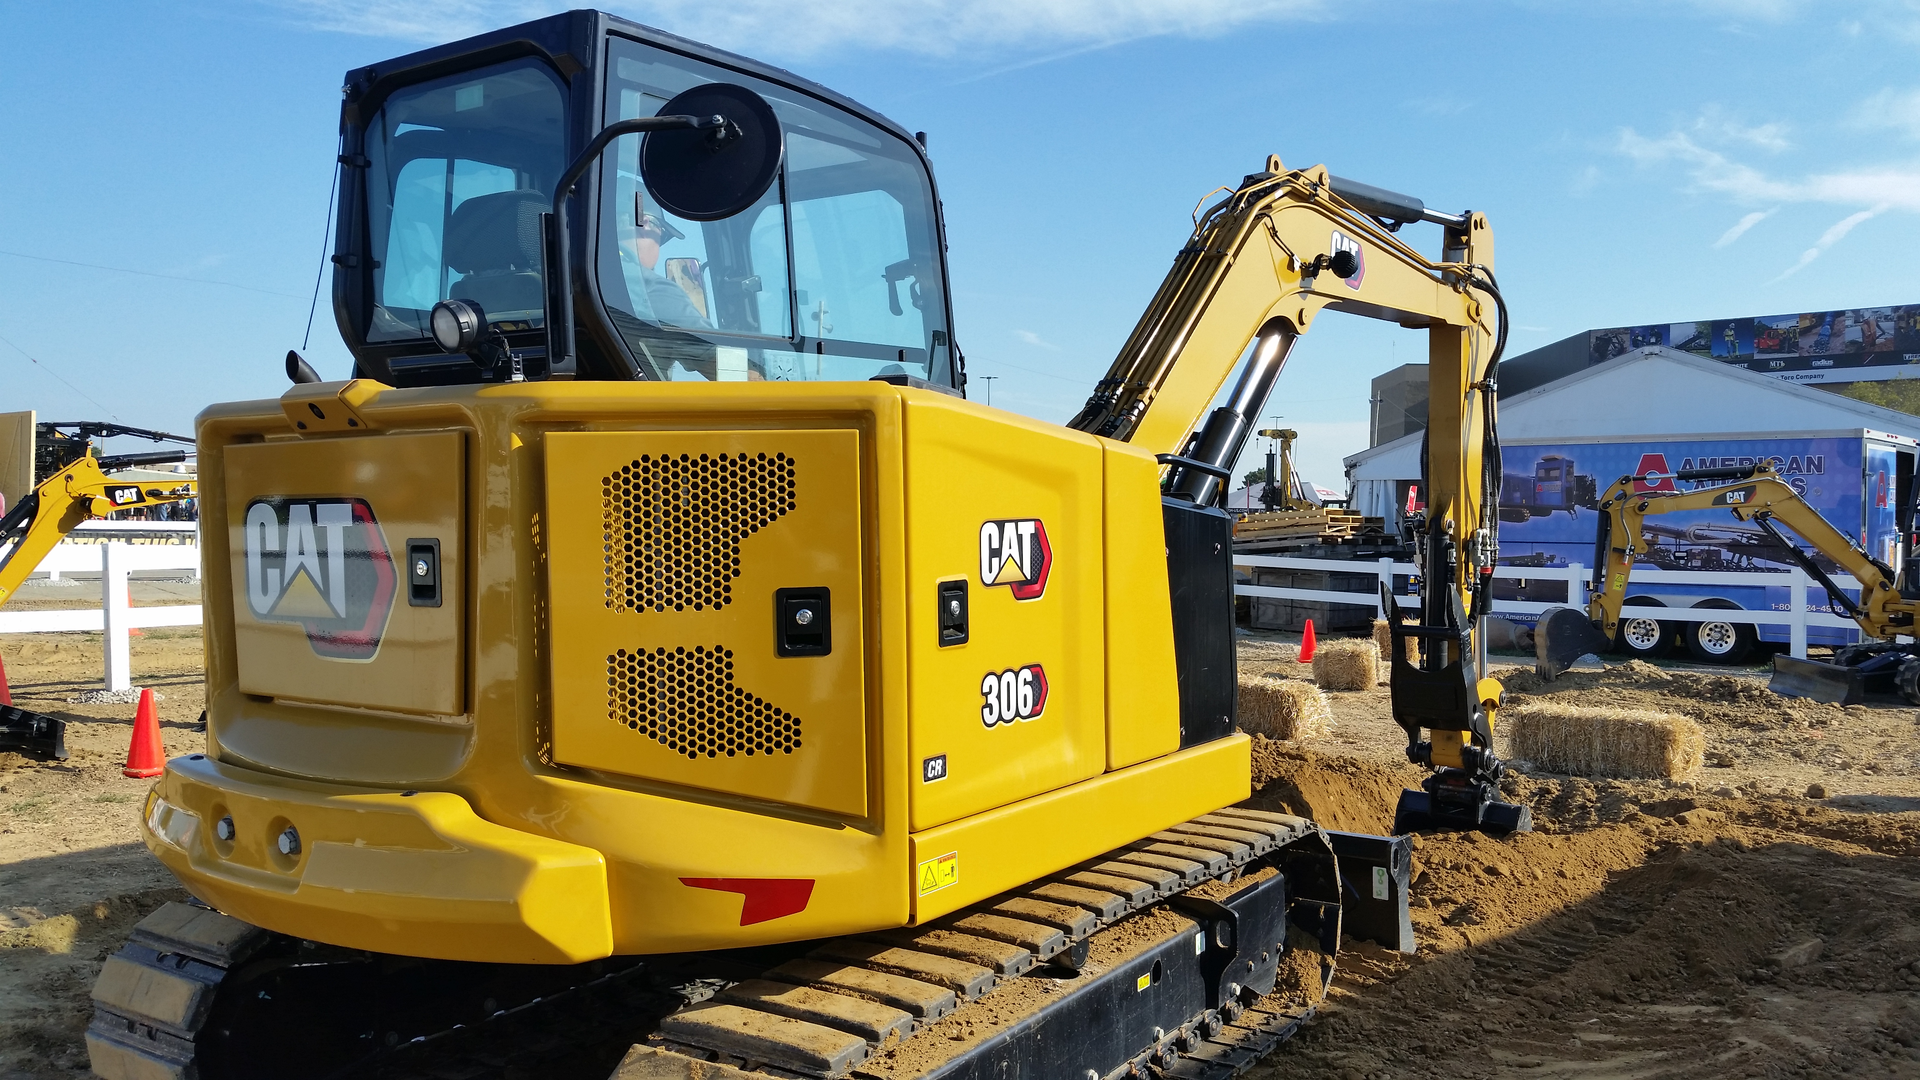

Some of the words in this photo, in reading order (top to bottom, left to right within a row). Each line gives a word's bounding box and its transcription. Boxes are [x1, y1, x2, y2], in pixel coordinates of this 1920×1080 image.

[1796, 373, 1825, 381] Company
[114, 487, 138, 504] CAT
[1726, 490, 1745, 504] CAT
[246, 502, 353, 619] CAT
[980, 520, 1036, 585] CAT
[982, 667, 1033, 725] 306
[927, 758, 943, 778] CR
